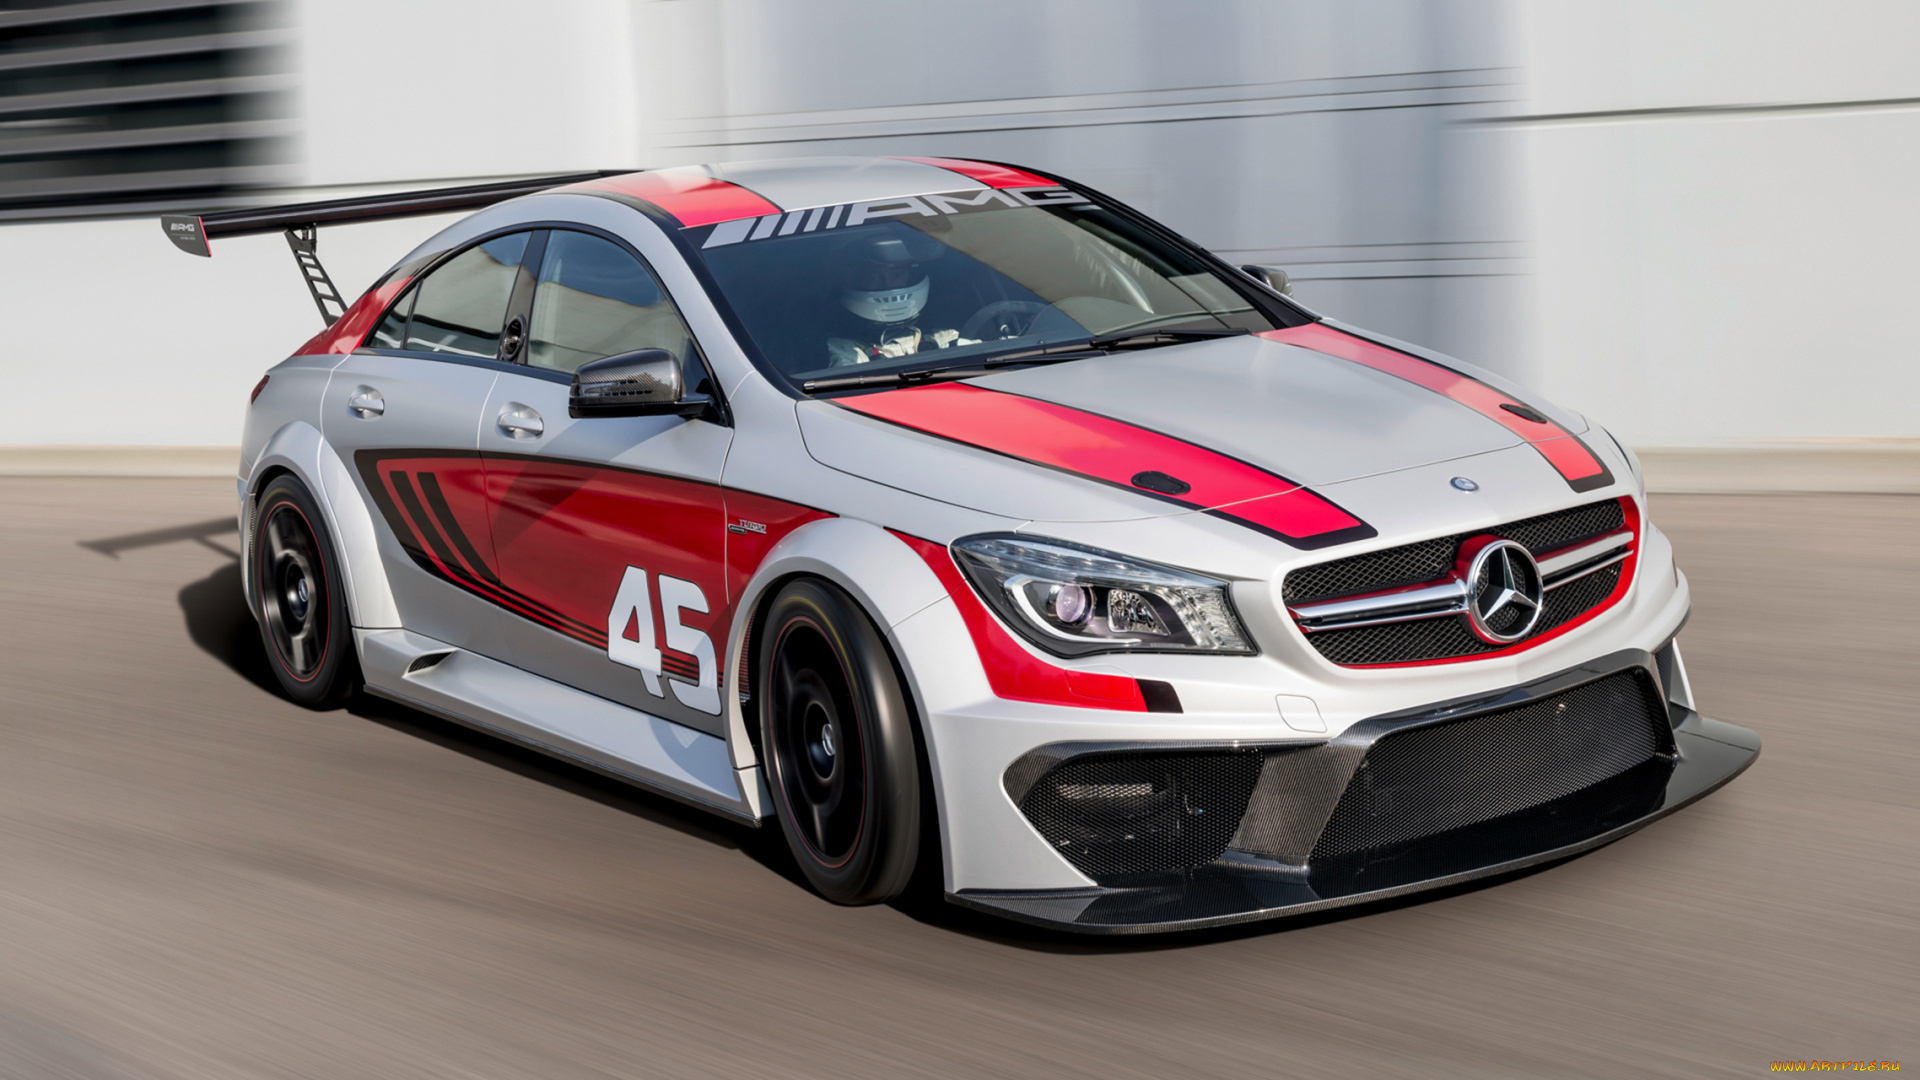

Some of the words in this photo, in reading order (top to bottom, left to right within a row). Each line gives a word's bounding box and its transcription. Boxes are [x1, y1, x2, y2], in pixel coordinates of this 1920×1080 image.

[845, 185, 1092, 226] AMG
[738, 518, 767, 532] TURBO
[607, 564, 722, 716] 45
